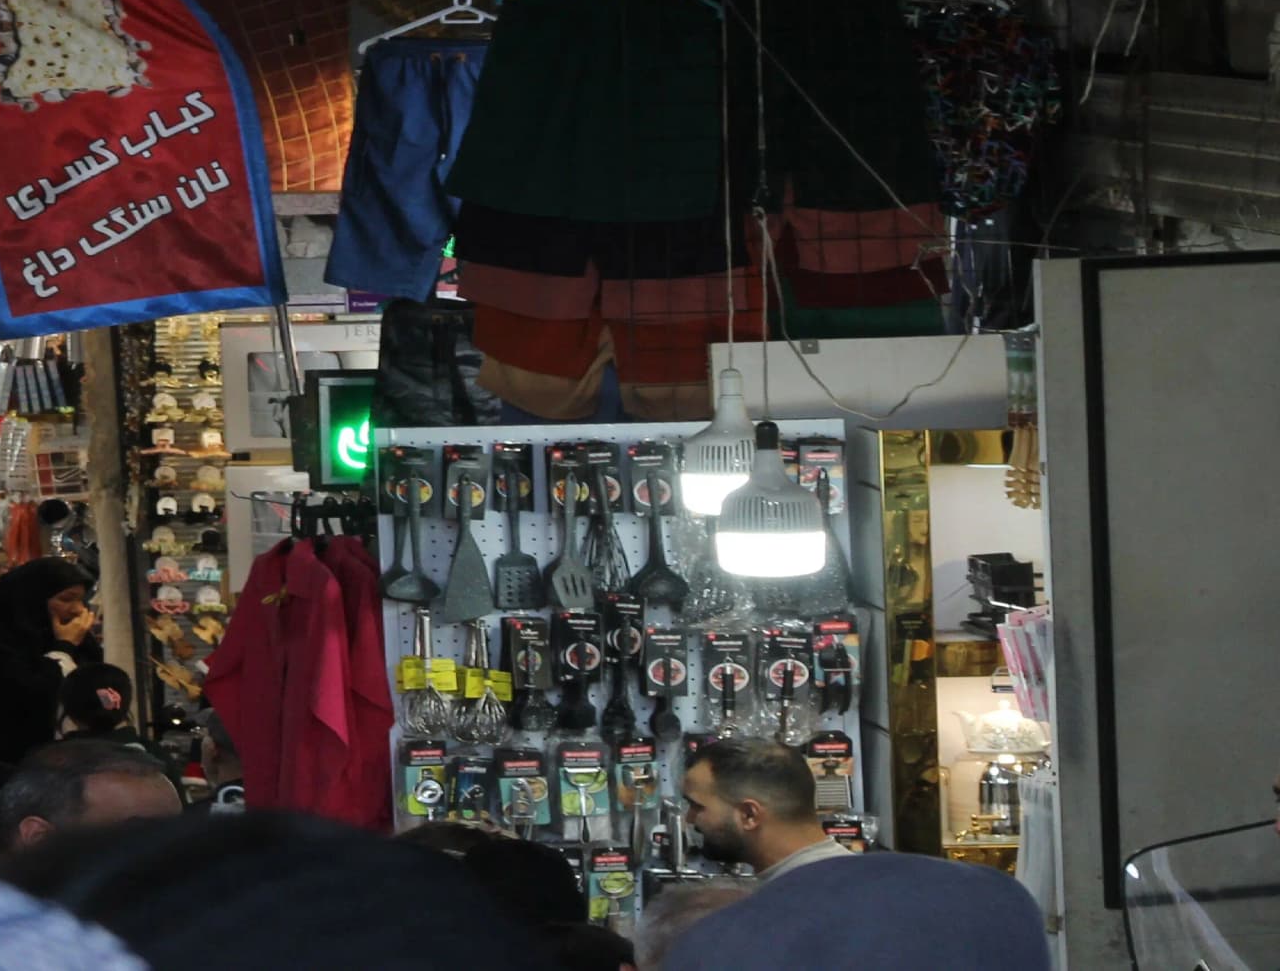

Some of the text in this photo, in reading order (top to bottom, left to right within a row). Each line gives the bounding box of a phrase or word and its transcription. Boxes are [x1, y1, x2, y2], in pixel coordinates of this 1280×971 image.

[5, 90, 216, 221] کباب کسری
[22, 160, 231, 299] نان سنگک داغ
